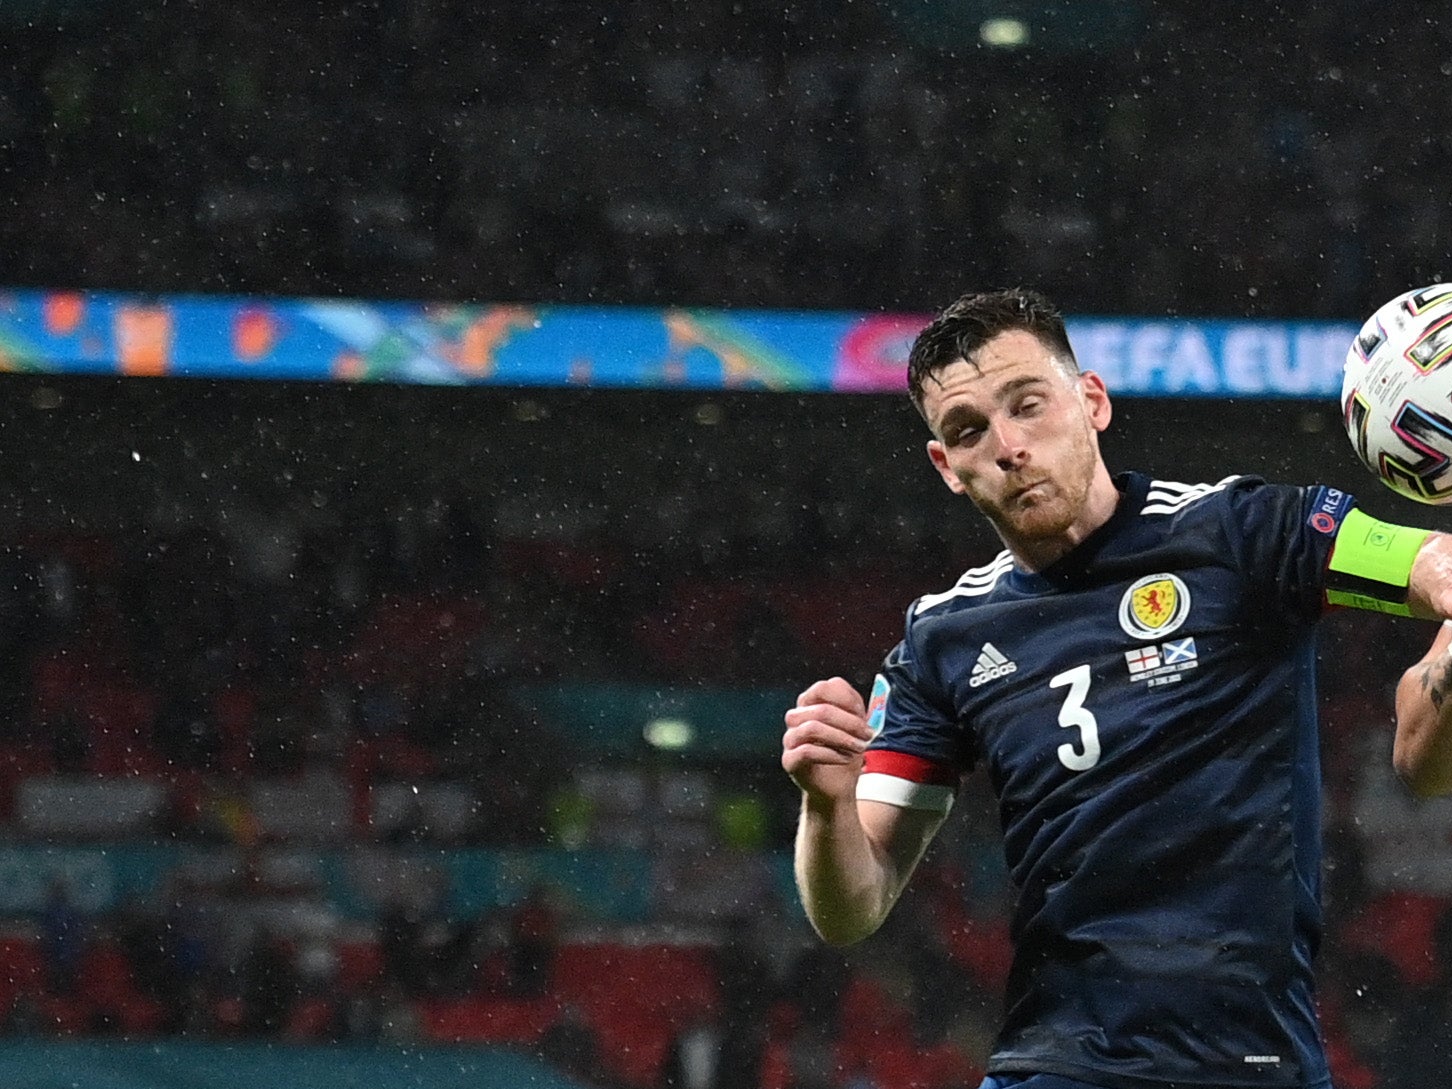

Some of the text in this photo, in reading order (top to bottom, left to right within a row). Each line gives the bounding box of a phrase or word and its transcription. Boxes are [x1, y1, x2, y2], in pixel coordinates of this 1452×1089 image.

[1223, 321, 1349, 393] EUR
[968, 661, 1018, 688] adidas
[1049, 664, 1101, 771] 3
